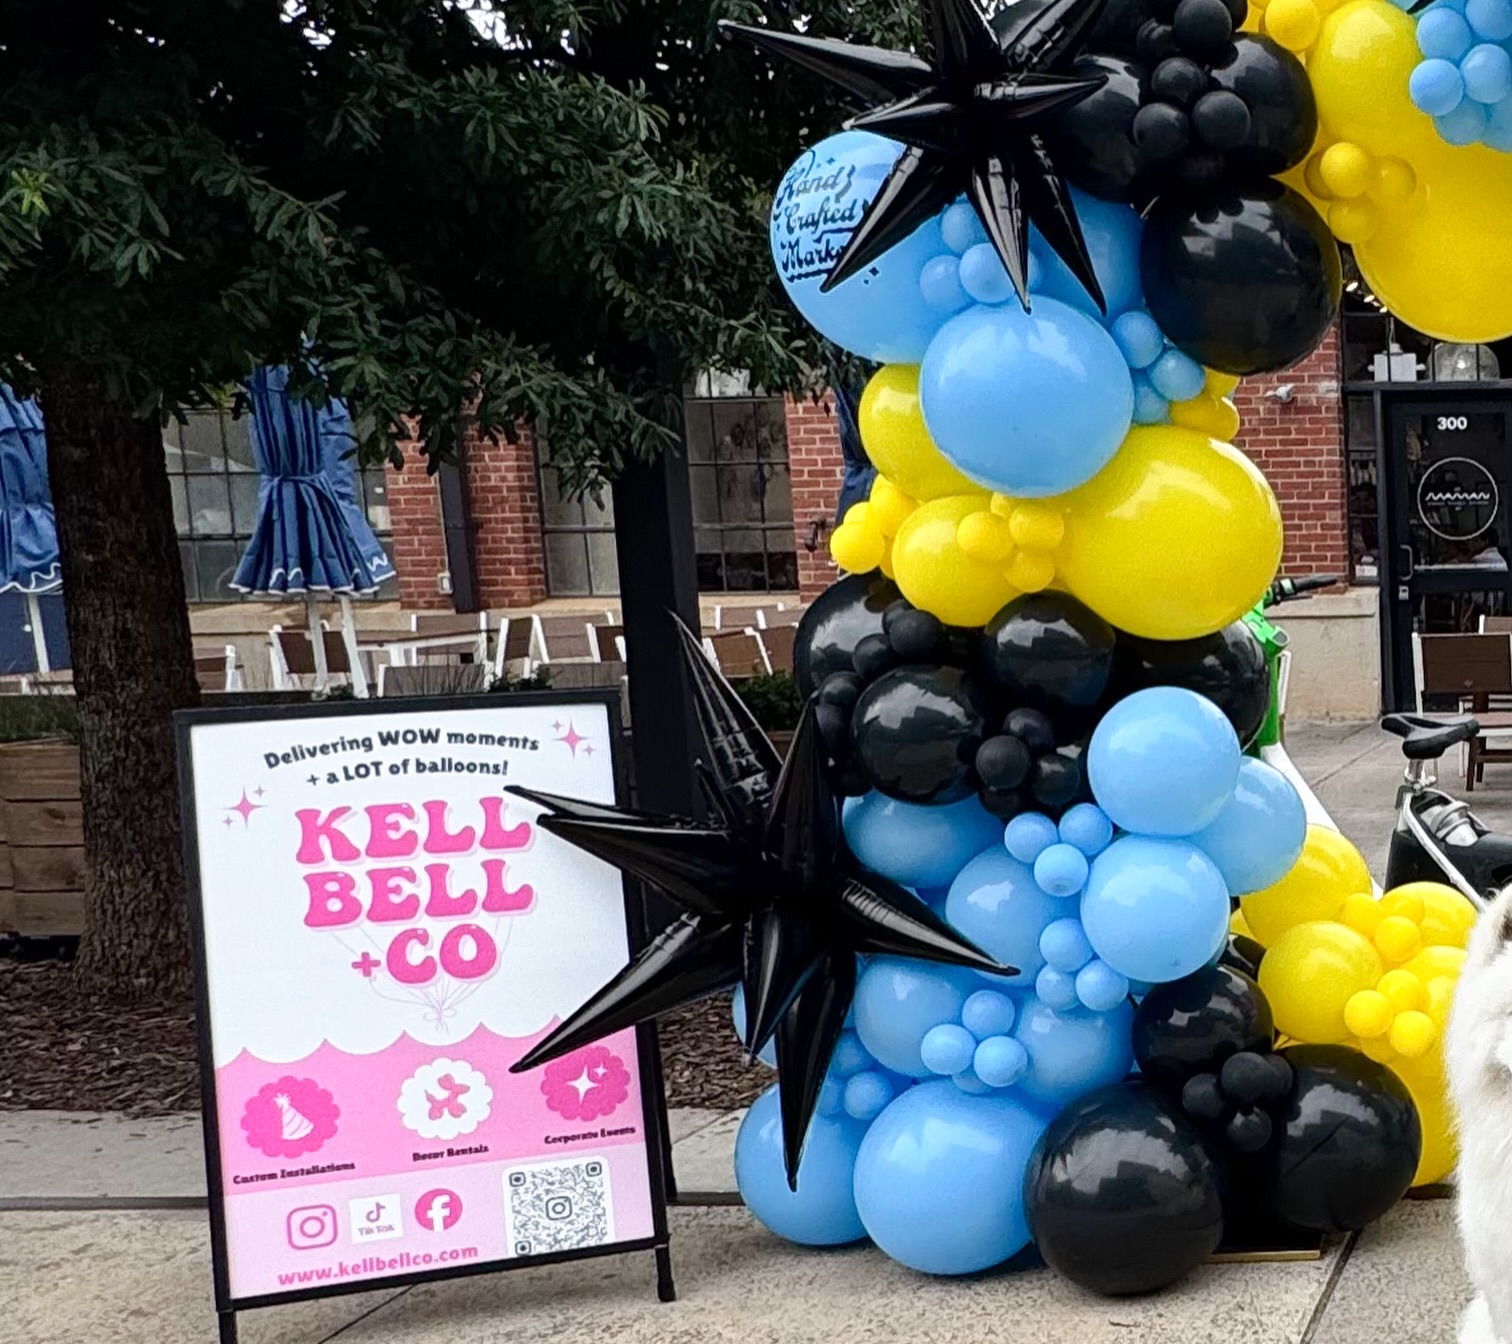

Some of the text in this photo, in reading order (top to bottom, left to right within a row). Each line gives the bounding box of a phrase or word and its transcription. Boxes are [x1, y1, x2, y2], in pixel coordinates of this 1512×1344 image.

[775, 165, 846, 210] Hand
[784, 195, 859, 235] Crafted
[1437, 416, 1468, 431] 300
[263, 728, 540, 769] Delivering WOW moments
[306, 757, 509, 786] + a LOT of balloons!
[294, 796, 532, 864] KELL
[303, 859, 534, 928] BELL
[233, 1161, 356, 1185] Custom Installations
[277, 1246, 478, 1286] www.kellbellco.com
